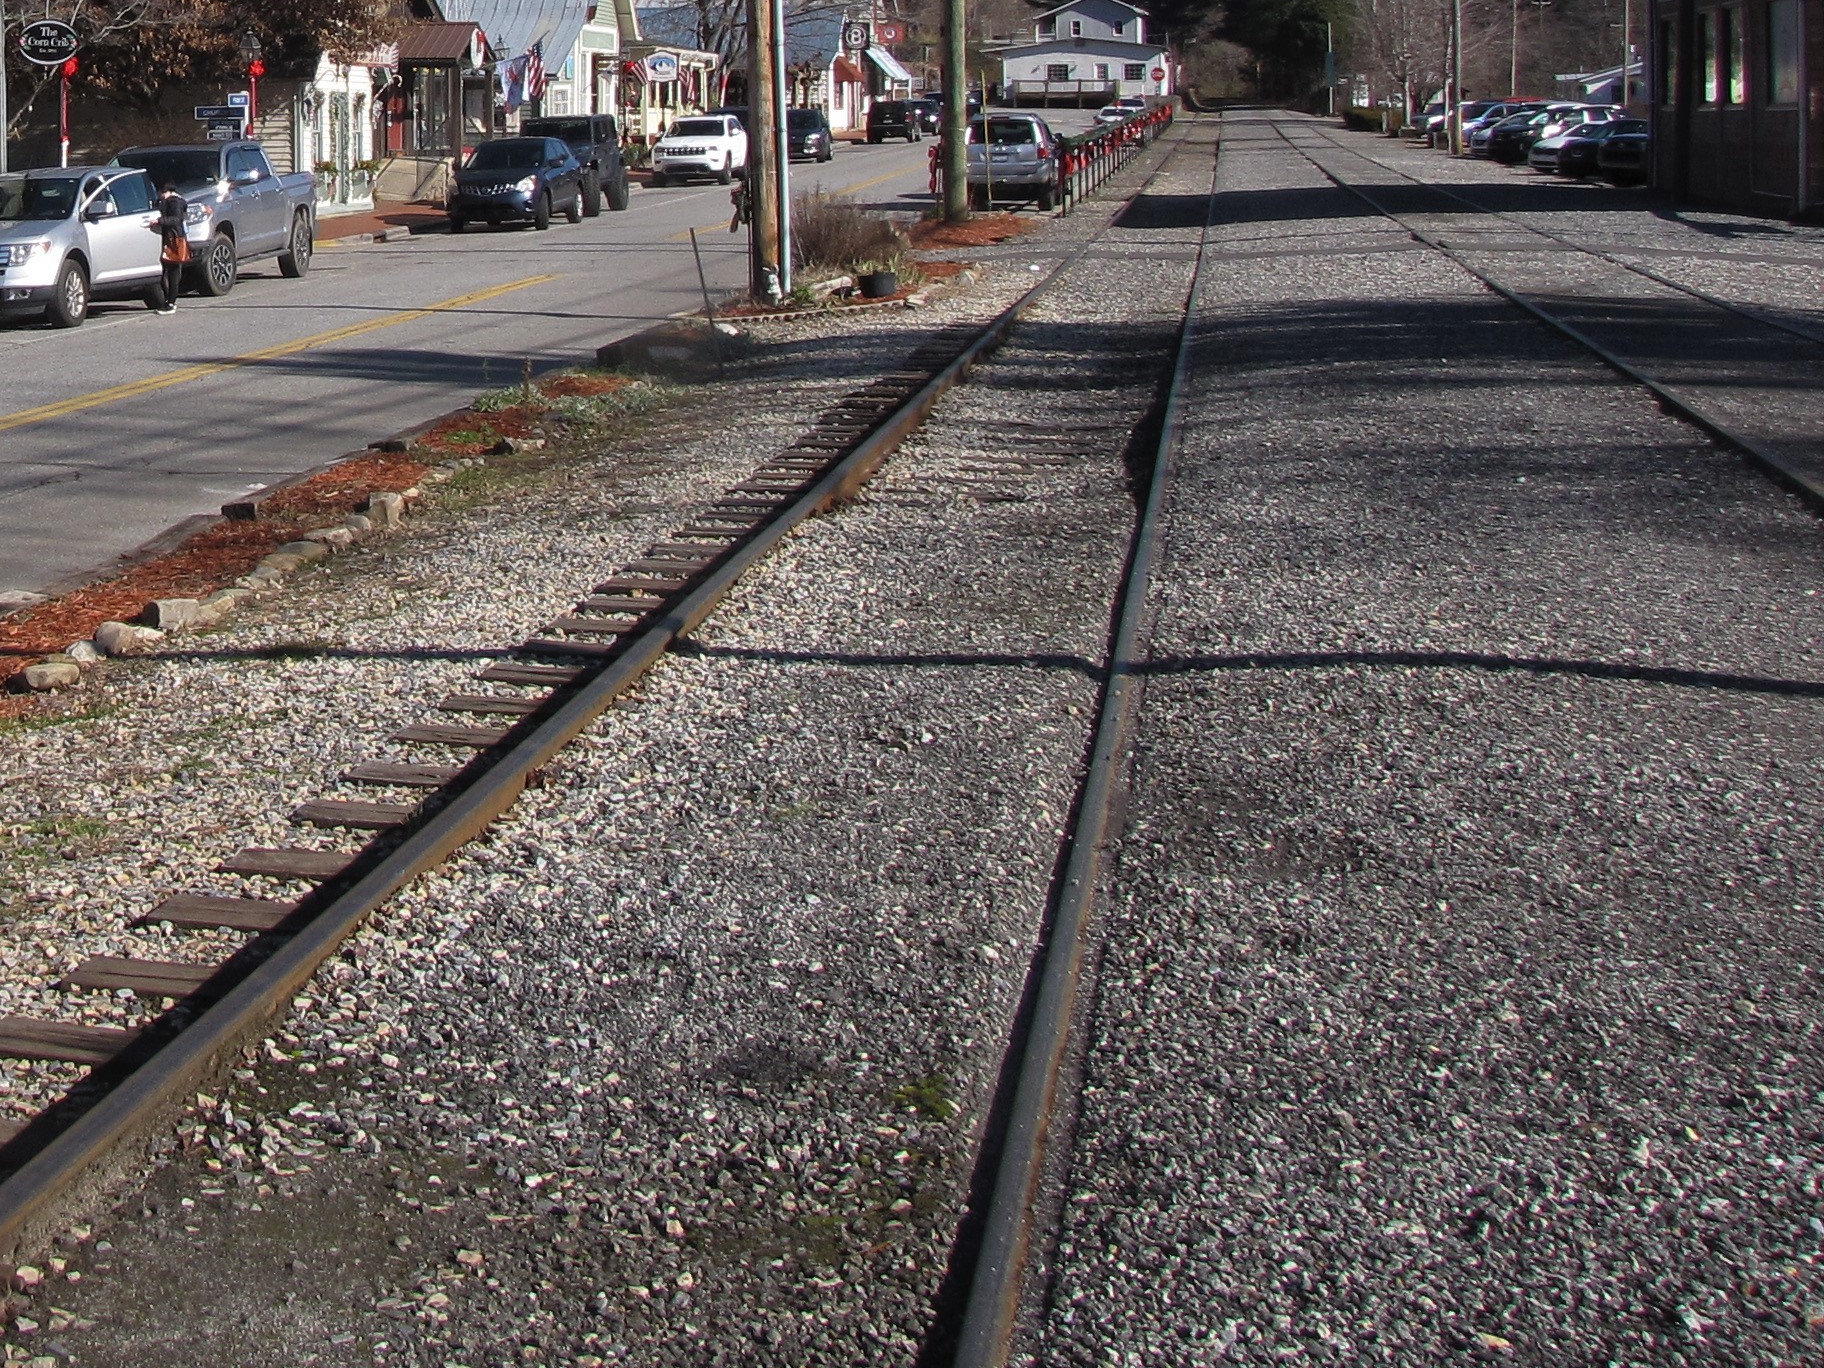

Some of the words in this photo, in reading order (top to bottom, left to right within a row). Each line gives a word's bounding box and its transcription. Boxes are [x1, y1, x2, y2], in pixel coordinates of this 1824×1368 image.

[39, 26, 58, 36] The
[27, 37, 49, 46] Corn
[50, 36, 69, 47] Crib
